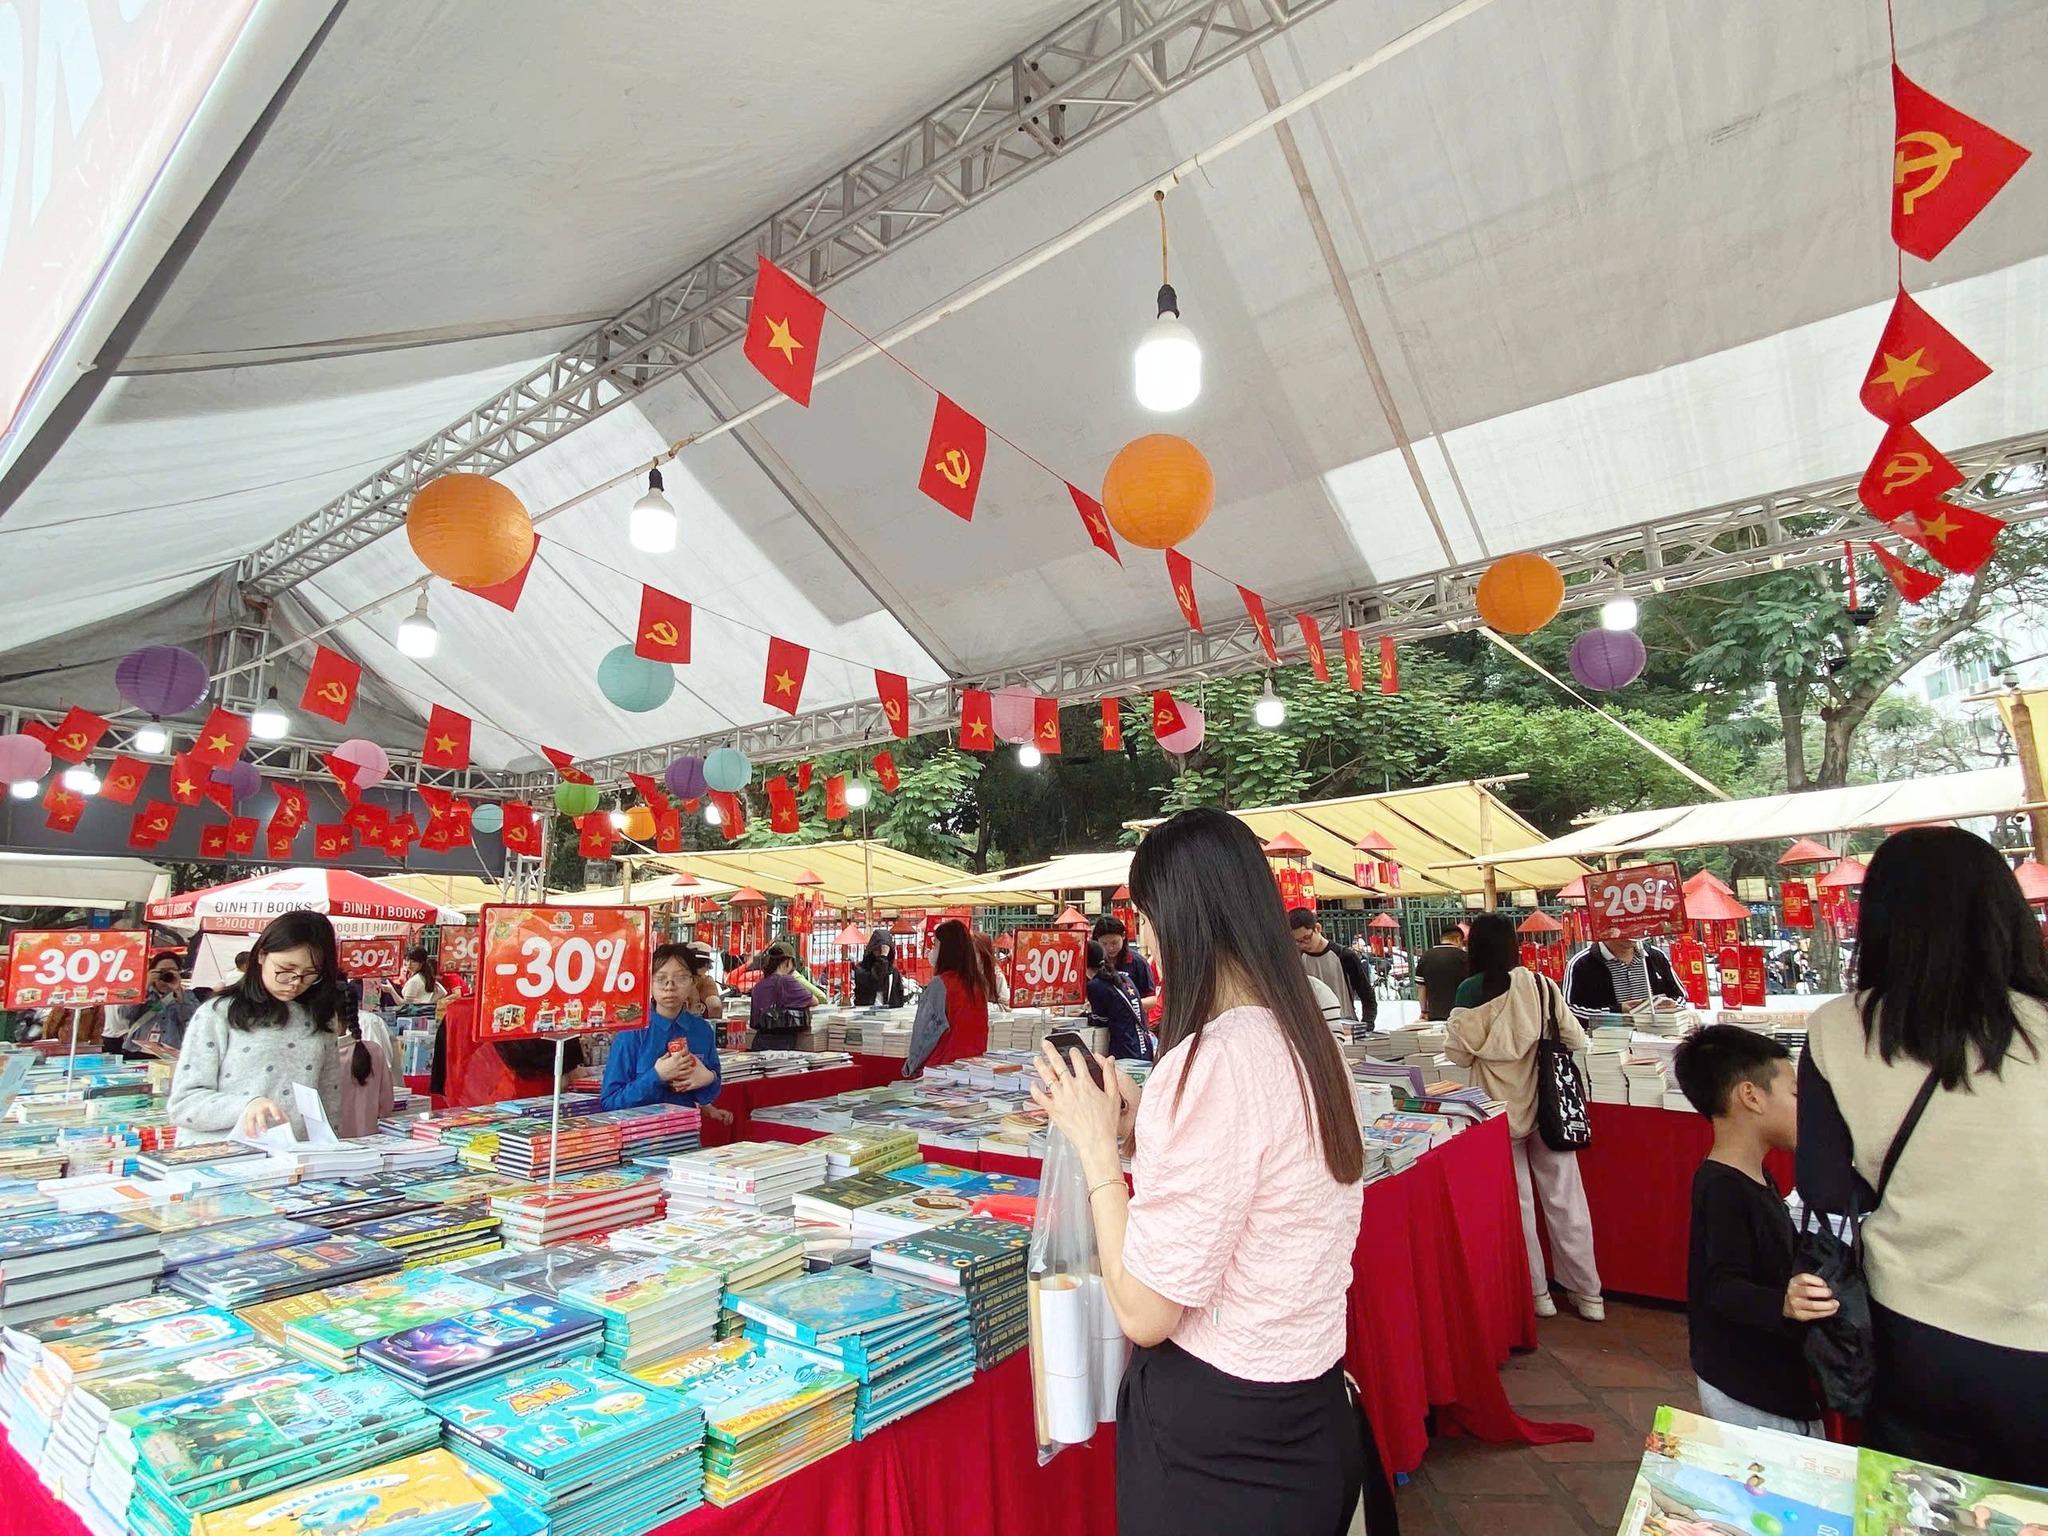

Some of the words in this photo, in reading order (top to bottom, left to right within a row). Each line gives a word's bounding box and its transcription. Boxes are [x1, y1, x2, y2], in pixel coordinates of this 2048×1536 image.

[267, 901, 313, 914] BOOKS
[387, 907, 427, 920] BOOKS
[1593, 880, 1675, 917] -20%
[18, 948, 135, 985] -30%
[342, 949, 394, 968] -30%
[494, 936, 636, 998] -30%
[1015, 948, 1078, 985] -30%
